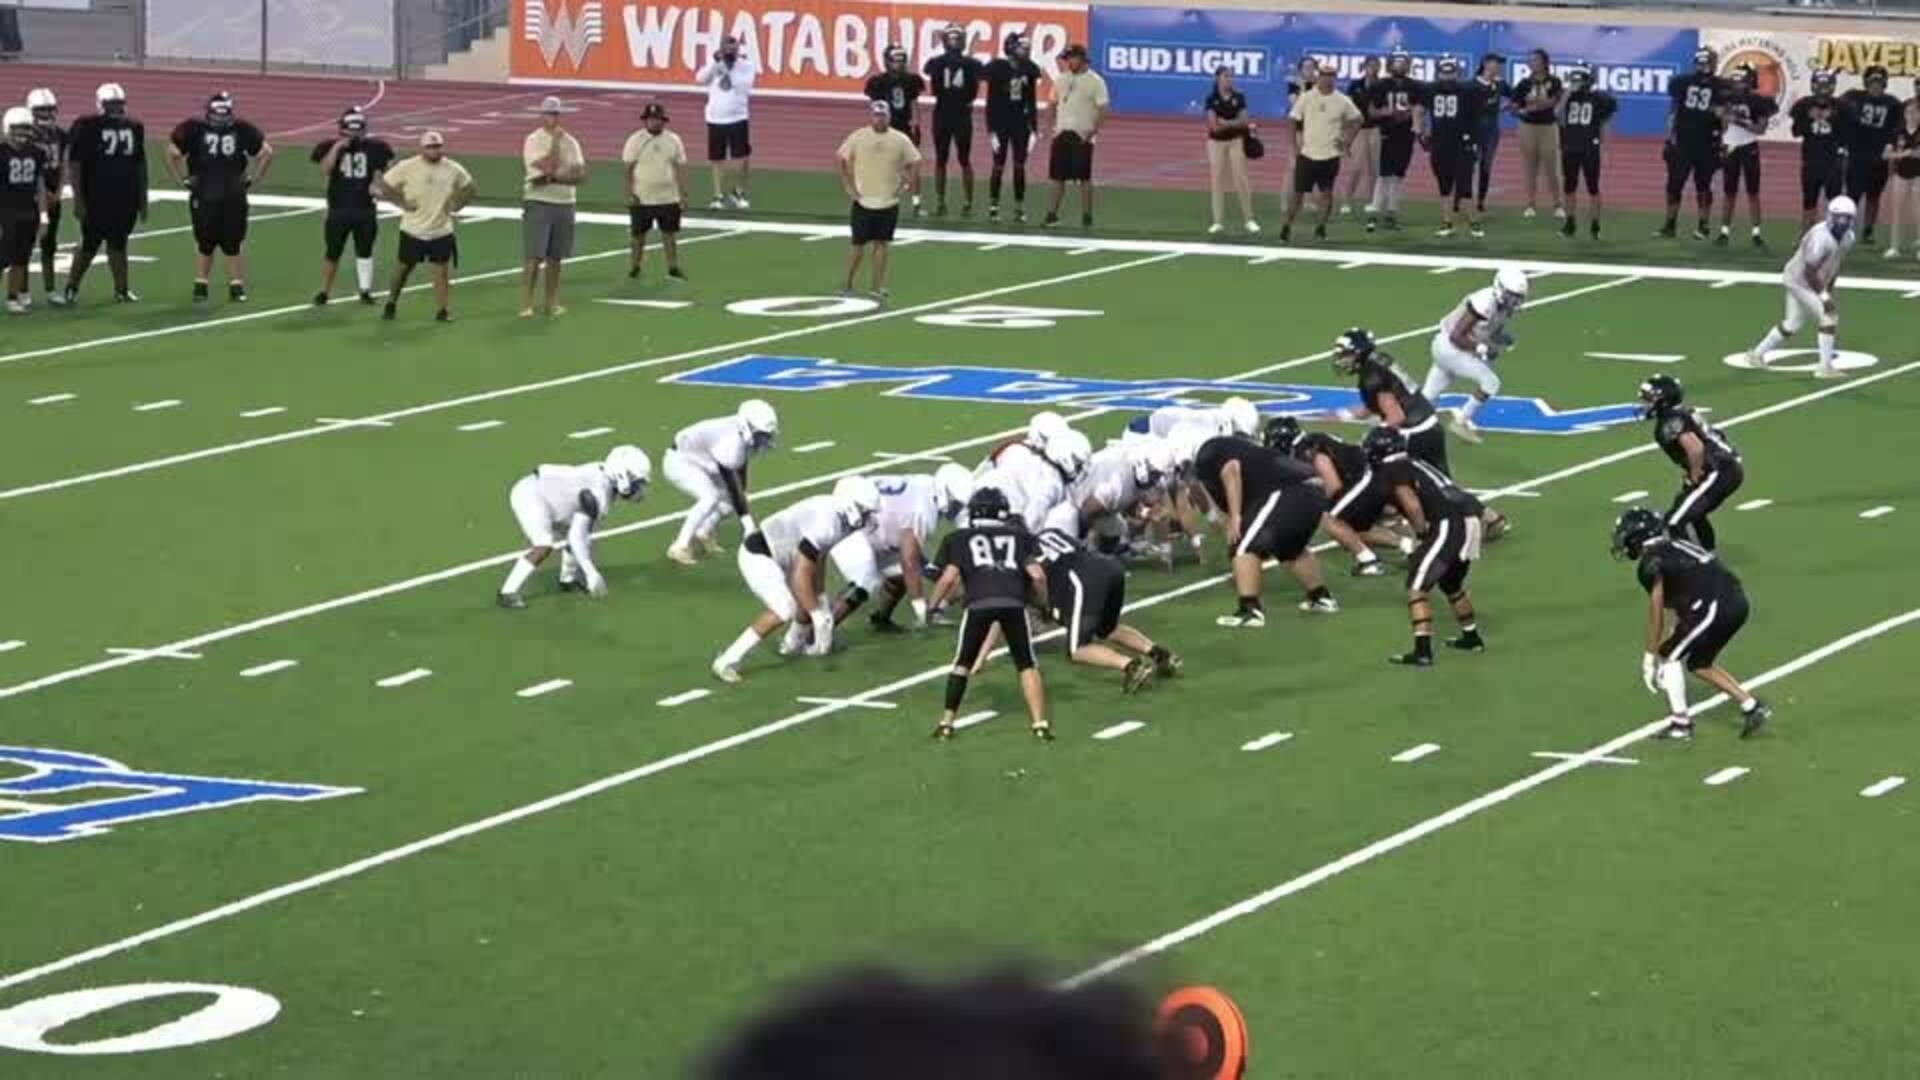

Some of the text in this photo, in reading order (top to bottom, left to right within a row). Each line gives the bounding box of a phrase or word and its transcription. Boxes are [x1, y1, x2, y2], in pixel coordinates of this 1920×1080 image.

[1109, 46, 1264, 76] BUD LIGHT
[943, 68, 964, 89] 14
[1590, 65, 1673, 93] IGHT
[1685, 86, 1713, 110] 53
[102, 128, 135, 156] 77
[204, 132, 236, 156] 78
[9, 157, 36, 184] 22
[339, 152, 367, 178] 43
[969, 535, 1018, 569] 87
